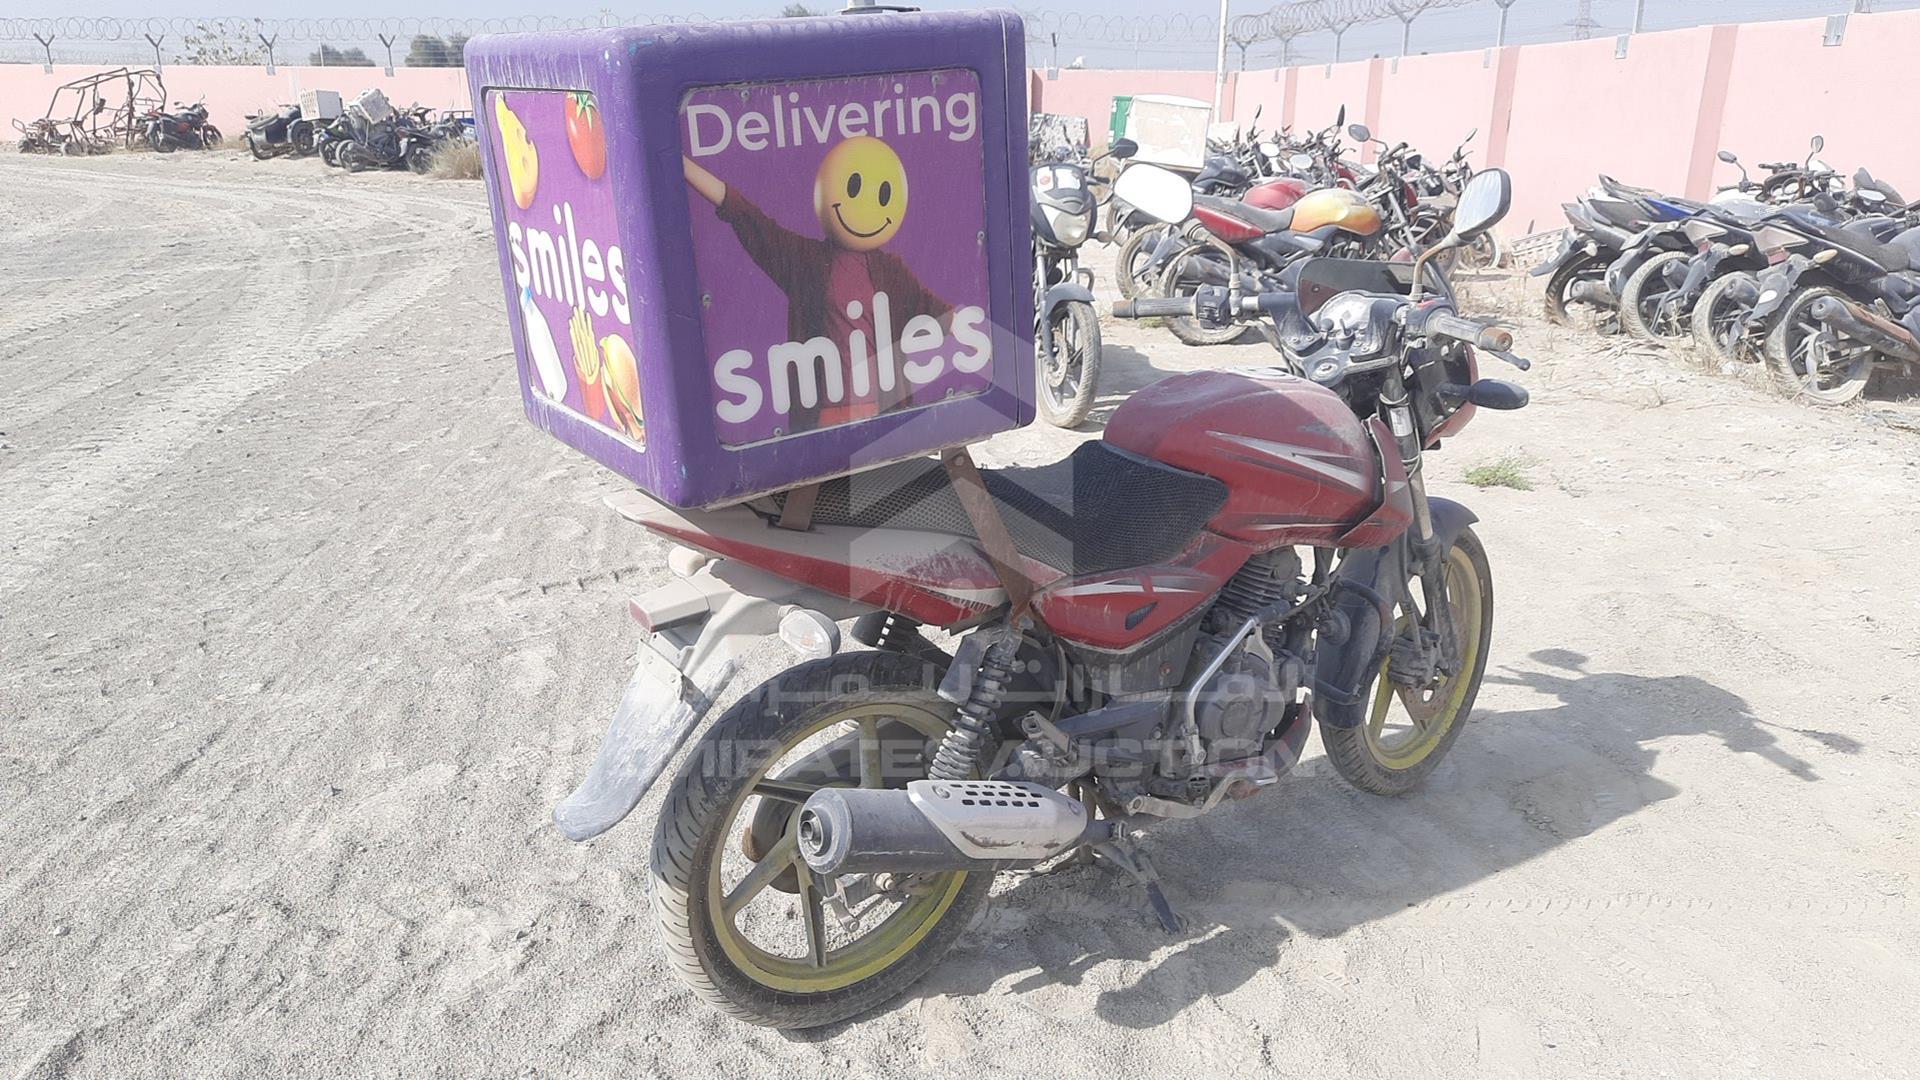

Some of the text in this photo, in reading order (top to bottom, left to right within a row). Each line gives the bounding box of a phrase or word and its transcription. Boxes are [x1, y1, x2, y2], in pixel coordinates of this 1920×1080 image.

[687, 84, 977, 157] Delivering
[508, 201, 631, 325] smiles
[714, 291, 992, 423] smiles
